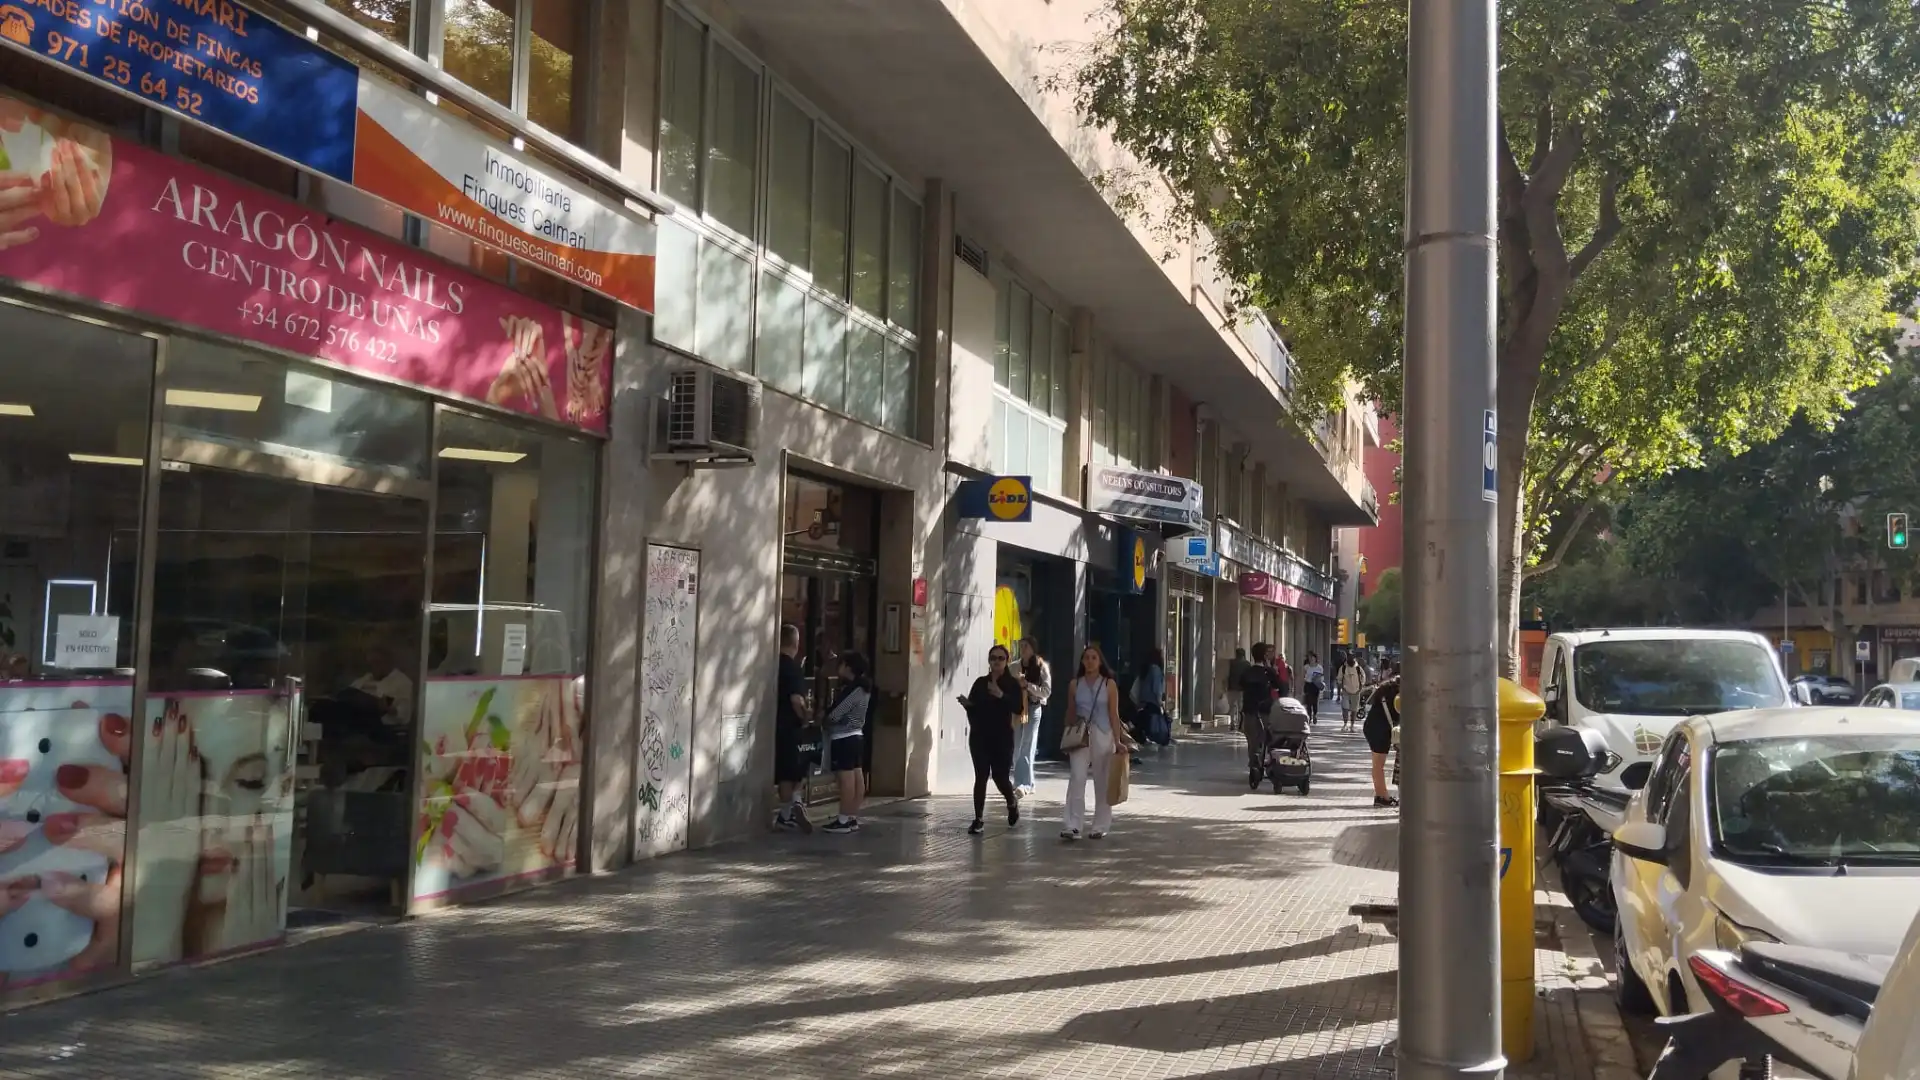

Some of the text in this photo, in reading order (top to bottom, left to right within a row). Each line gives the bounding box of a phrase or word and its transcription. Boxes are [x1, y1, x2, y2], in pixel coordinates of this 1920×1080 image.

[47, 31, 203, 115] 971 25 64 52
[96, 15, 123, 44] DE
[128, 30, 259, 104] PROPIETARIOS
[167, 17, 191, 45] DE
[196, 32, 263, 78] FINCAS
[463, 174, 587, 250] Finques Caimari
[484, 150, 571, 213] Inmobiliaria
[151, 177, 464, 314] ARAGÓN NAILS
[437, 202, 603, 287] www.finquescaimari.com
[182, 240, 440, 343] CENTRO DE UÑAS
[238, 301, 397, 363] +34 672 576 422
[1102, 475, 1182, 496] NEELYS CONSULTORS
